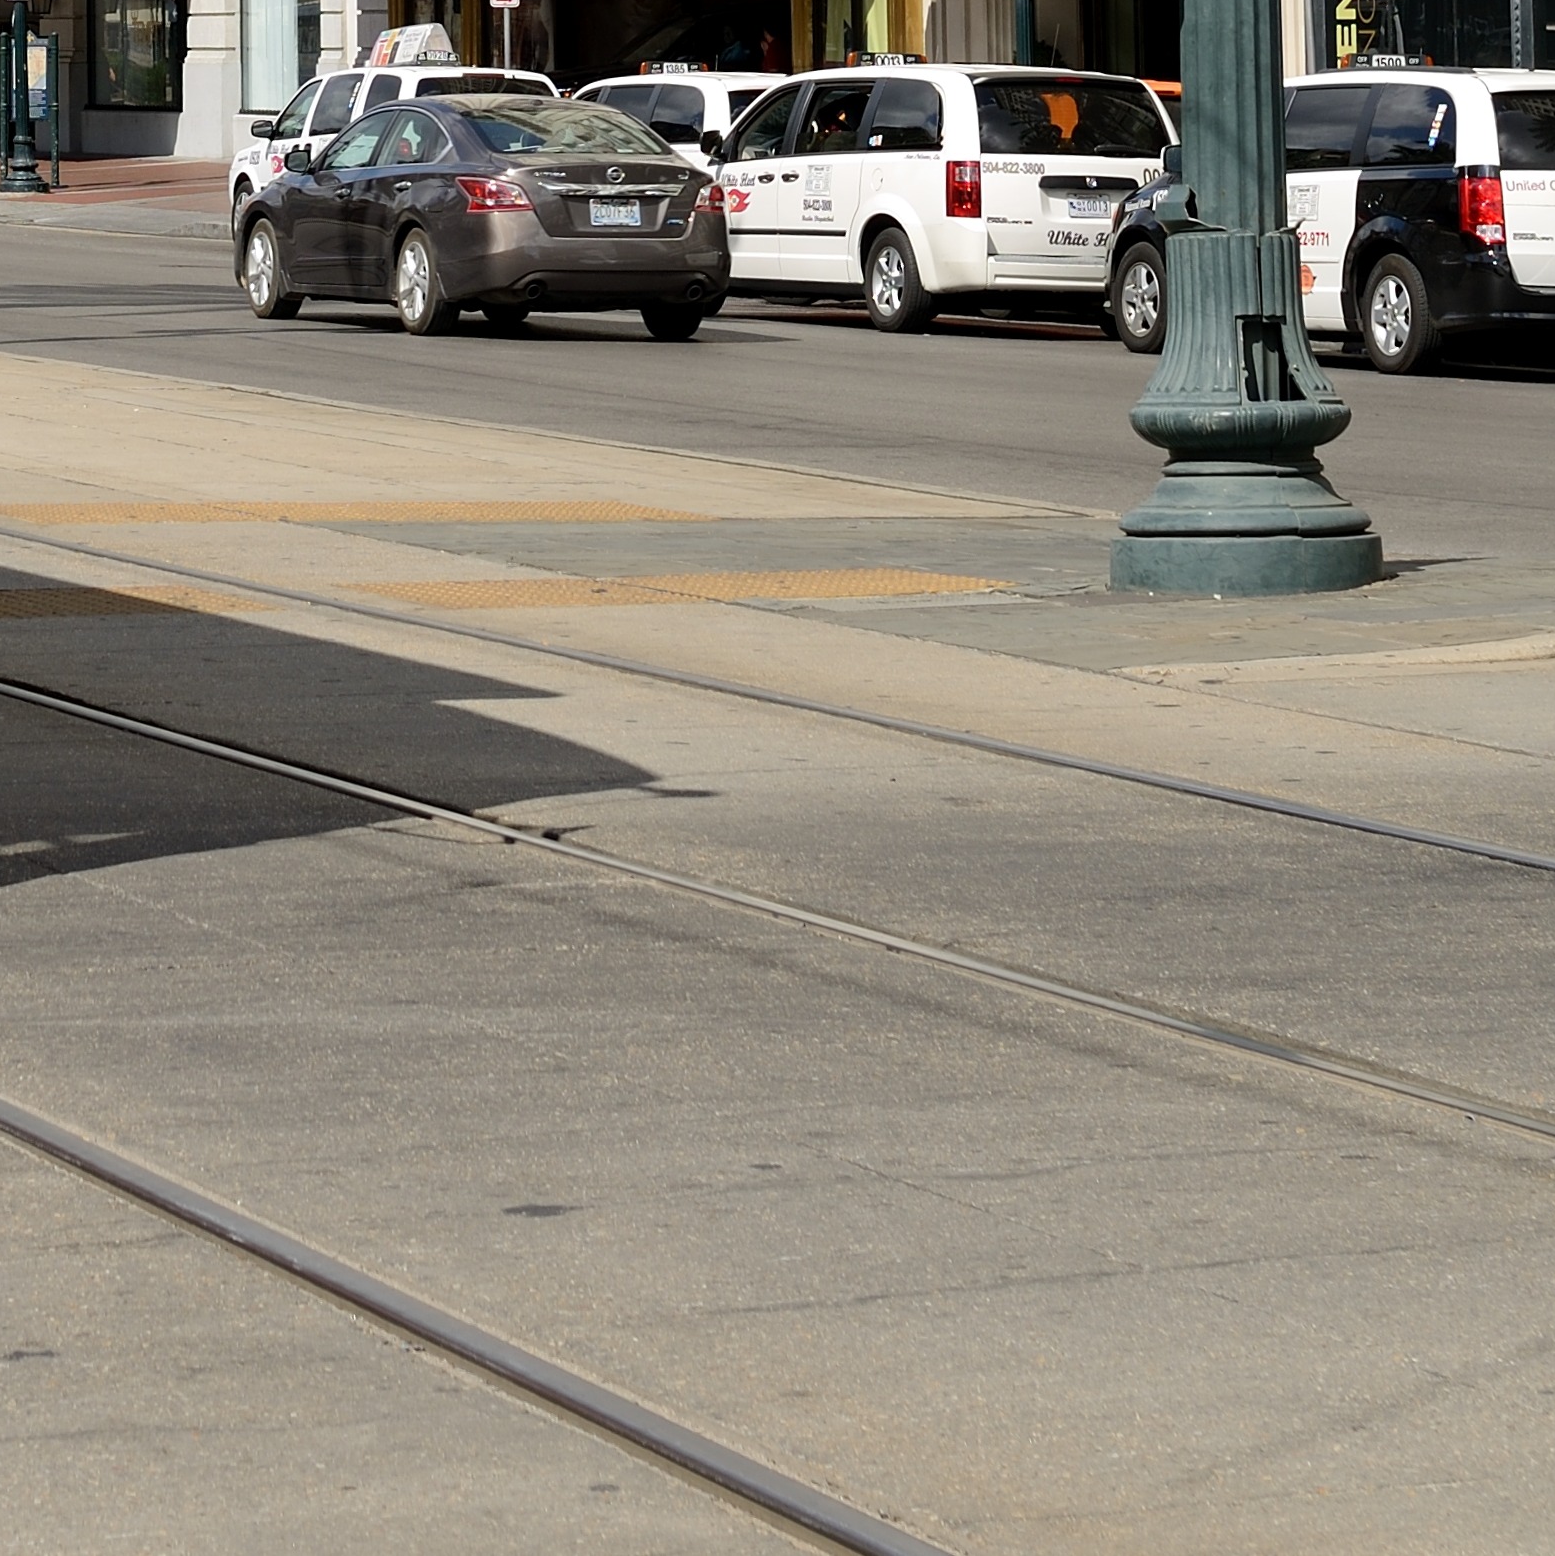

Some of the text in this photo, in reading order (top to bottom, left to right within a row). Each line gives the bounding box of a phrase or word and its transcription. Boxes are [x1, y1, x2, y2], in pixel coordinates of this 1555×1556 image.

[665, 63, 685, 73] 1385
[982, 162, 1045, 175] 504-822-3800
[1505, 180, 1546, 192] United
[1086, 200, 1109, 214] 0013
[1047, 230, 1090, 247] White
[1299, 231, 1330, 247] 22-9771
